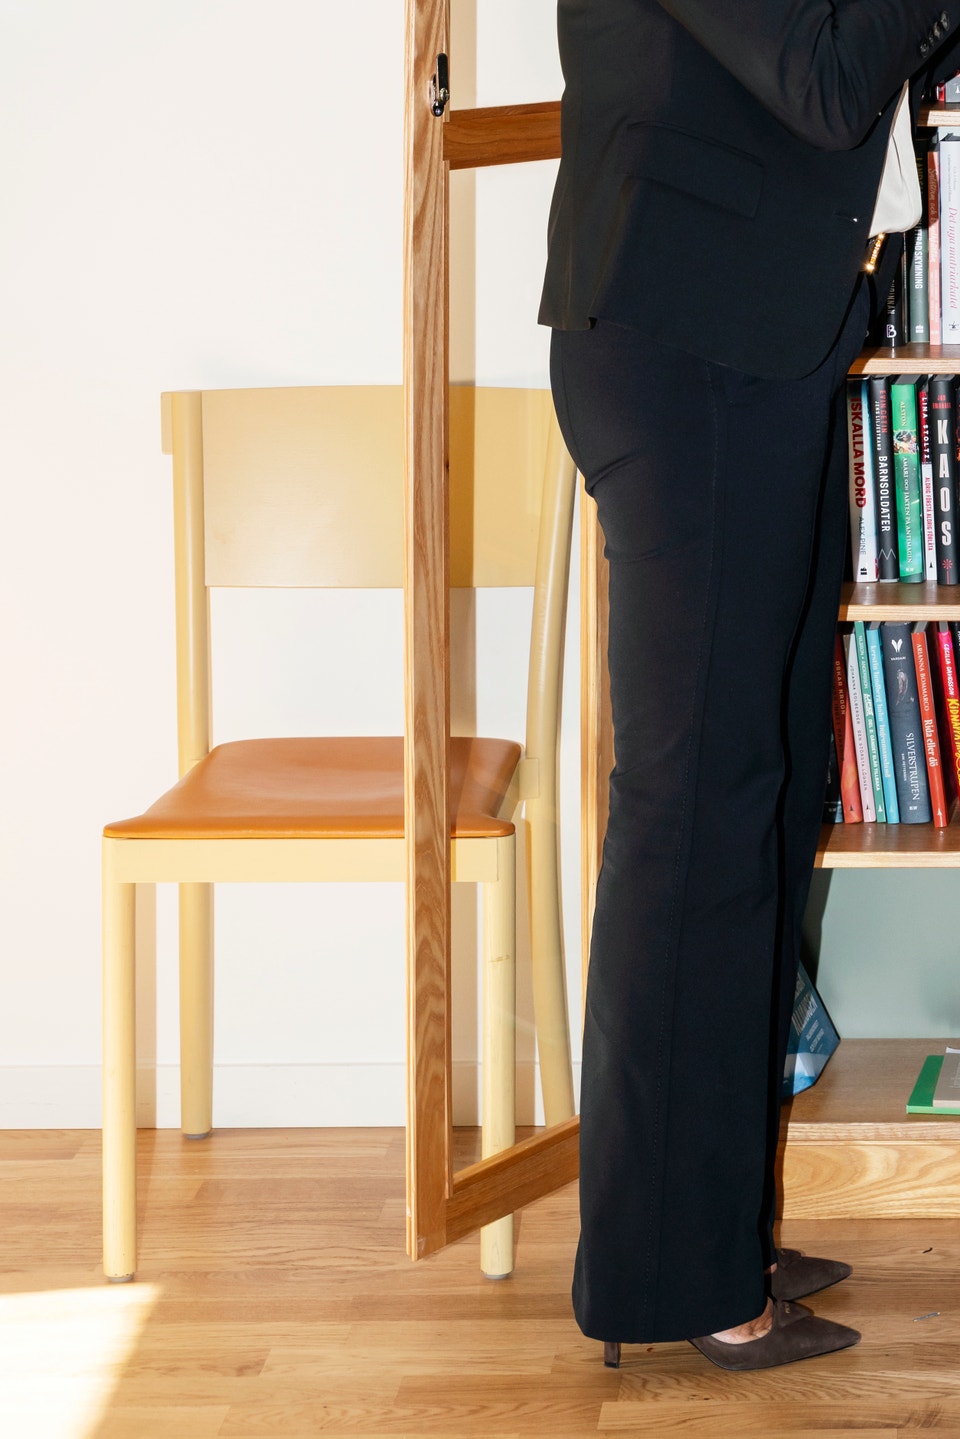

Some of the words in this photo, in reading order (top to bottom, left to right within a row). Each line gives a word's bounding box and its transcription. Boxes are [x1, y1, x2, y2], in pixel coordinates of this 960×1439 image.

[850, 396, 865, 457] ISKALLA
[921, 397, 929, 420] LINA
[854, 462, 867, 509] MORD
[878, 455, 891, 532] BARNSOLDATER
[936, 419, 953, 546] KAOS
[915, 644, 926, 672] ARIANNA
[919, 673, 931, 712] BOMMARCO
[923, 718, 934, 738] Rida
[927, 738, 937, 756] eller
[905, 732, 921, 801] SILVERSTRUPEN
[929, 756, 939, 768] dö
